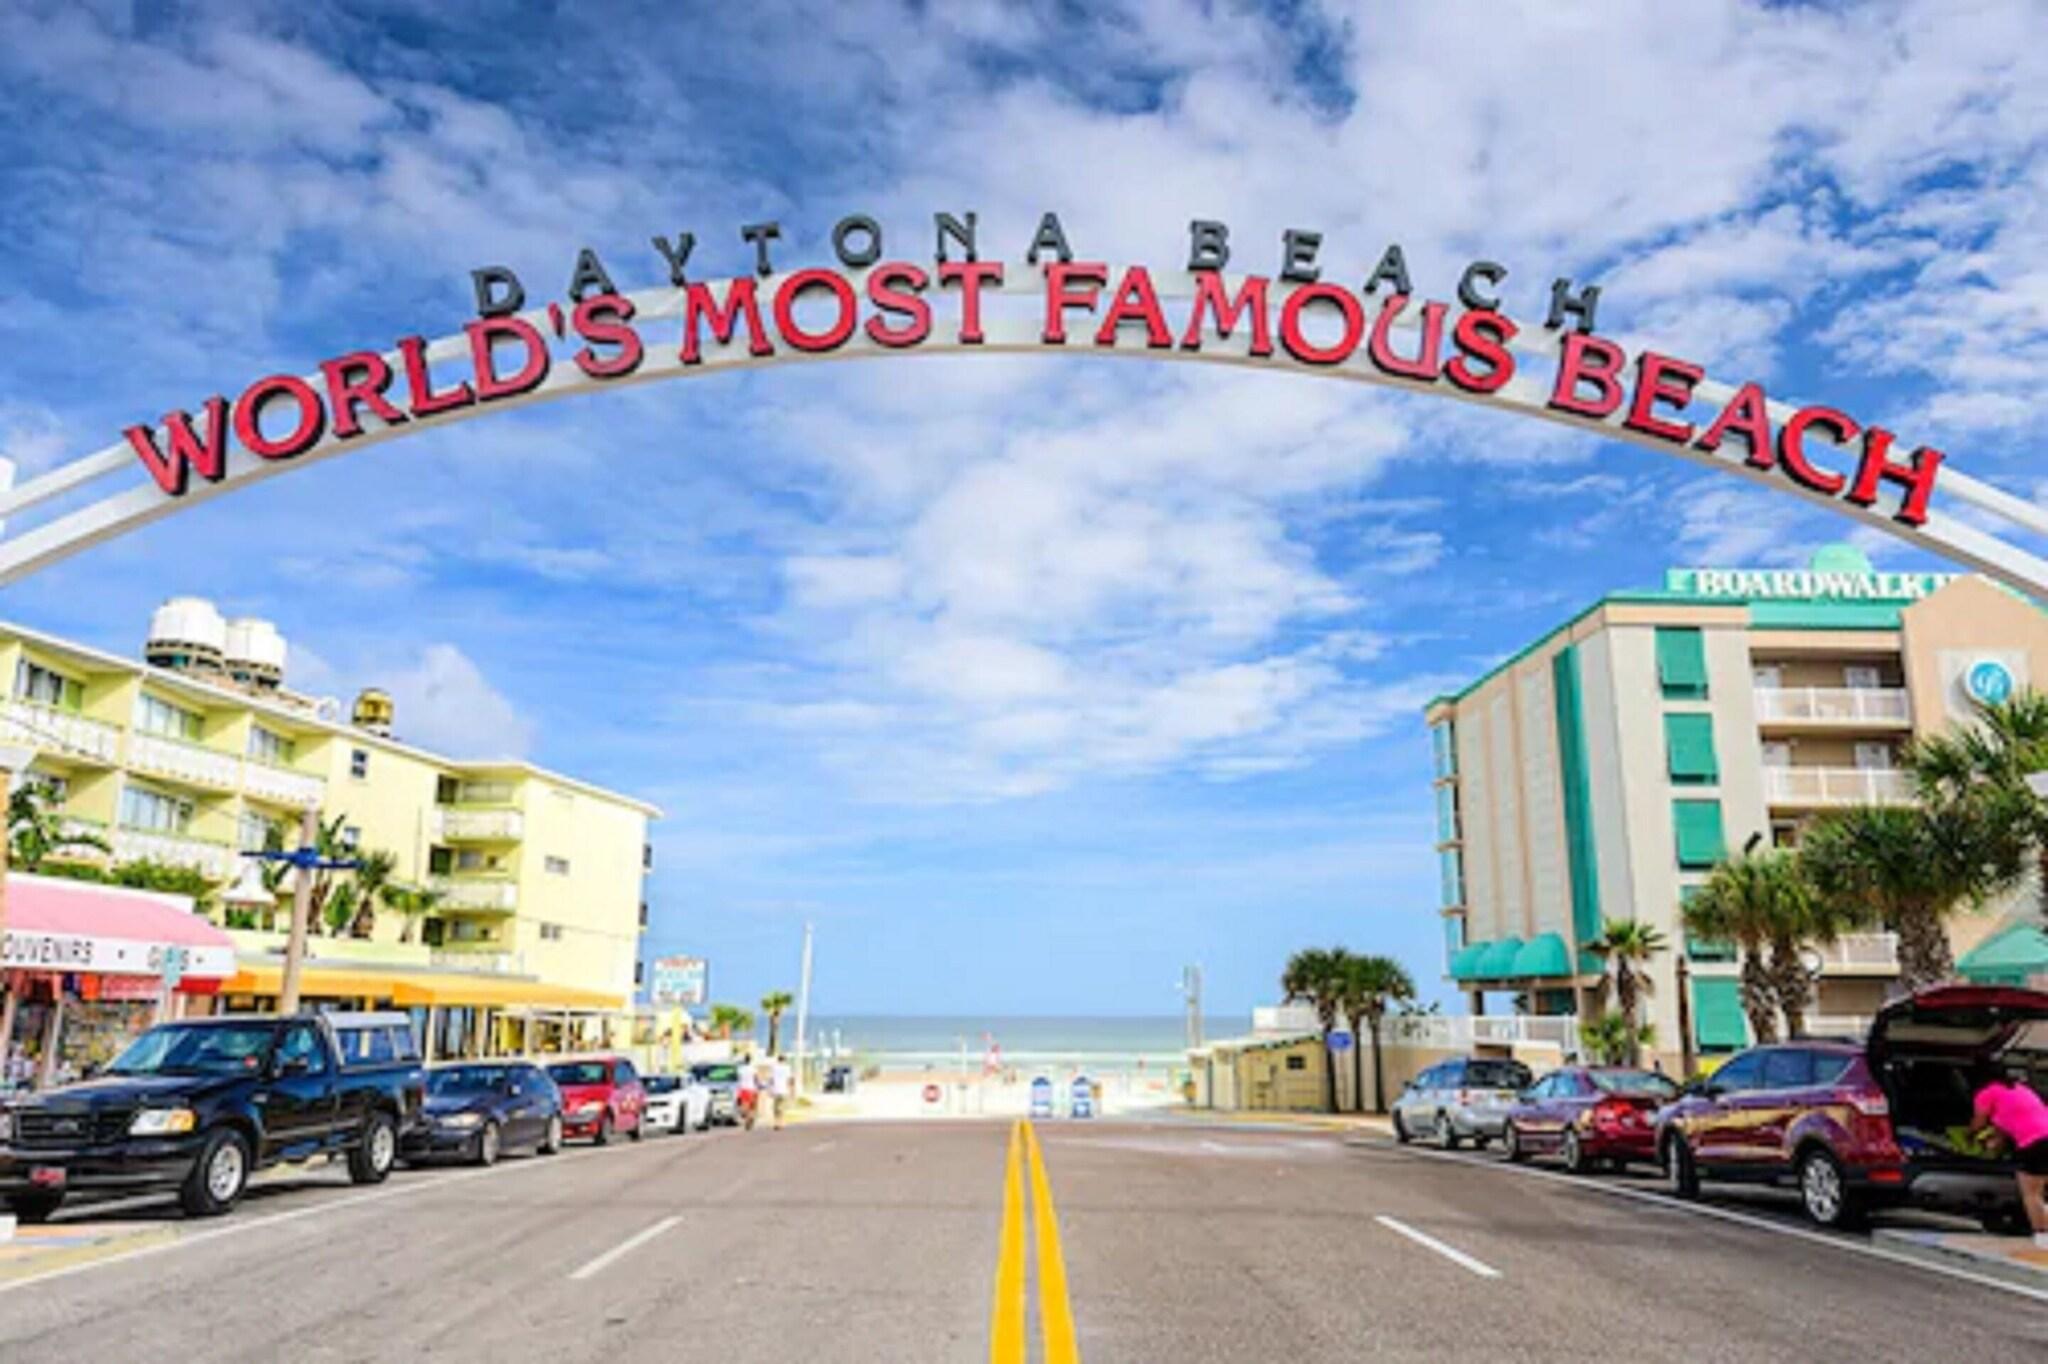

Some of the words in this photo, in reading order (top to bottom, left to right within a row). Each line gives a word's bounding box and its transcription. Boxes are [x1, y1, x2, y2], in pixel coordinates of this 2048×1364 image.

[470, 212, 1072, 318] DAYTONA
[1187, 219, 1602, 332] BEACH
[123, 293, 644, 496] WORLD'S
[679, 262, 1003, 364] MOST
[1042, 262, 1518, 393] FAMOUS
[1547, 331, 1945, 527] BEACH
[1696, 571, 1925, 599] BOARDWALK
